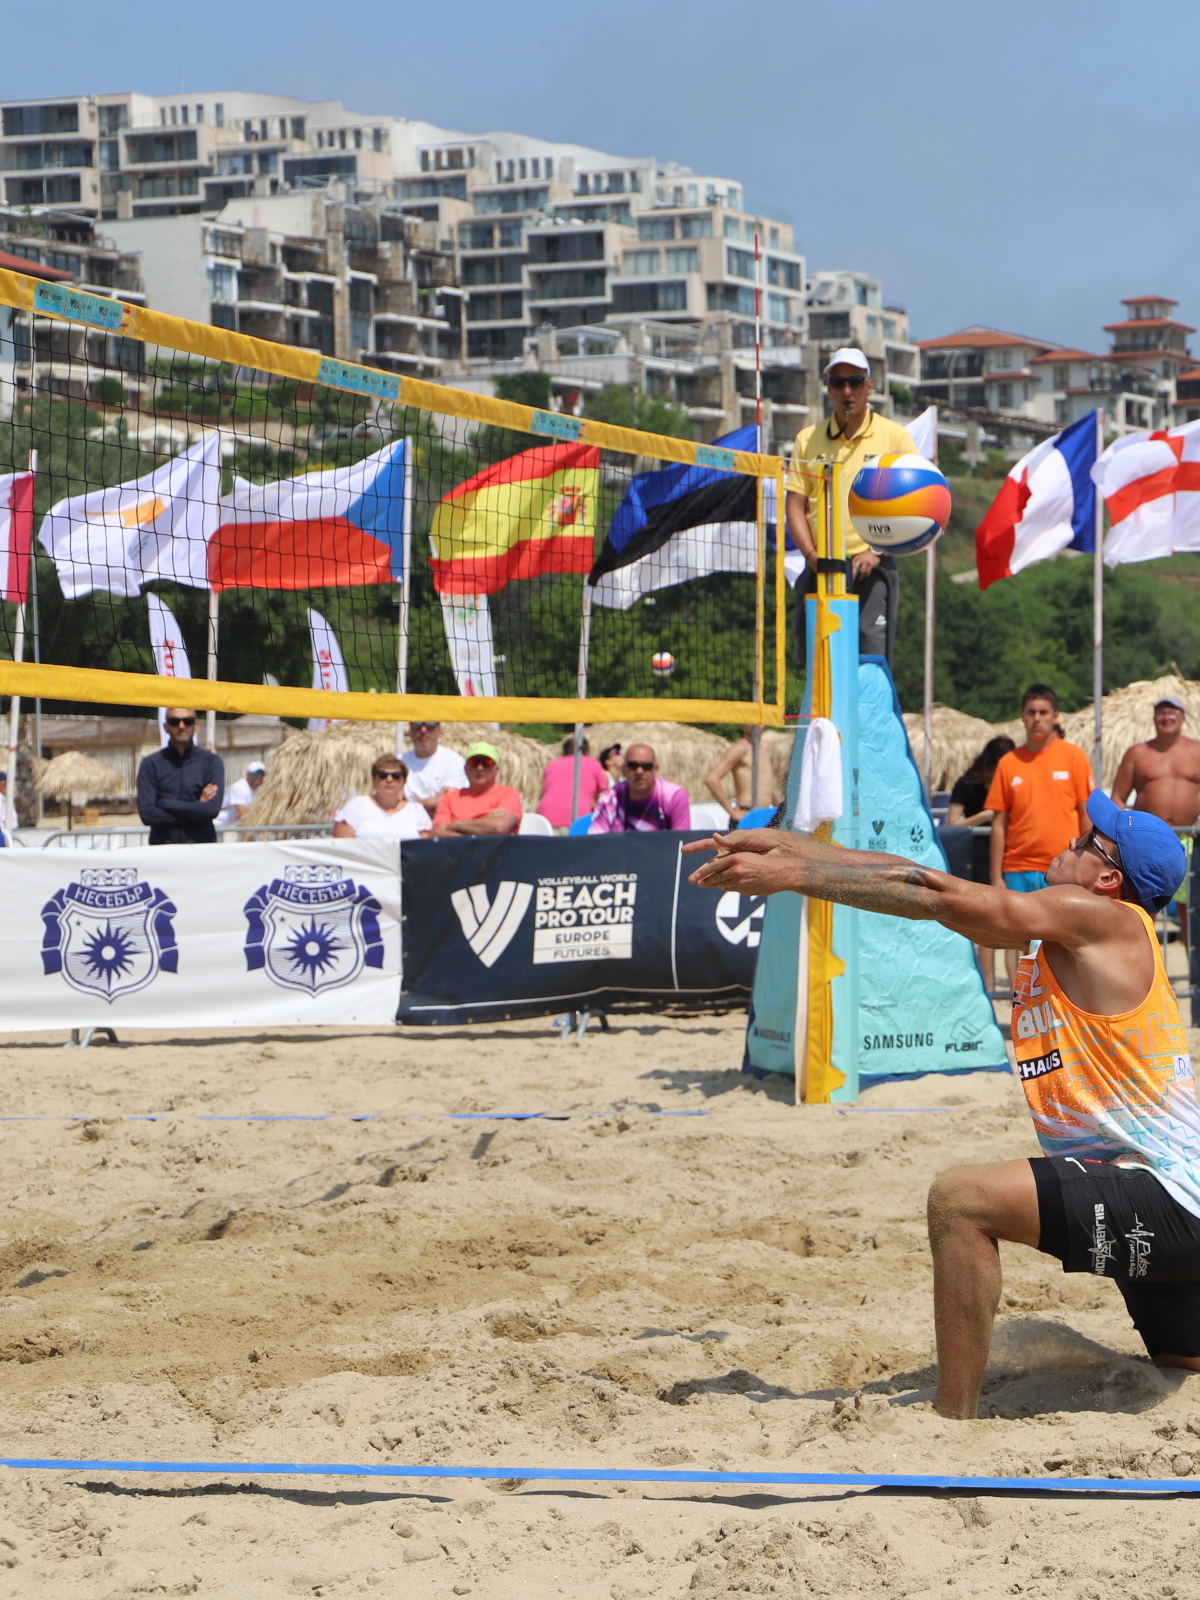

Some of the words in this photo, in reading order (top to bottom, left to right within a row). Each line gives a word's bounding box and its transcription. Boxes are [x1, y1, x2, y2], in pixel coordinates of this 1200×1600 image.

[538, 875, 599, 886] VOLLEYBALL
[600, 873, 638, 883] WORLD
[74, 886, 144, 908] НЕСЕБЪР
[277, 882, 348, 904] НЕСЕБЪР
[536, 882, 637, 911] BEACH
[535, 909, 578, 929] PRO
[579, 906, 635, 925] TOUR
[555, 930, 610, 944] EUROPE
[553, 946, 611, 959] FUTURES
[863, 1032, 934, 1050] SAMSUNG
[1139, 1240, 1151, 1276] Pulse
